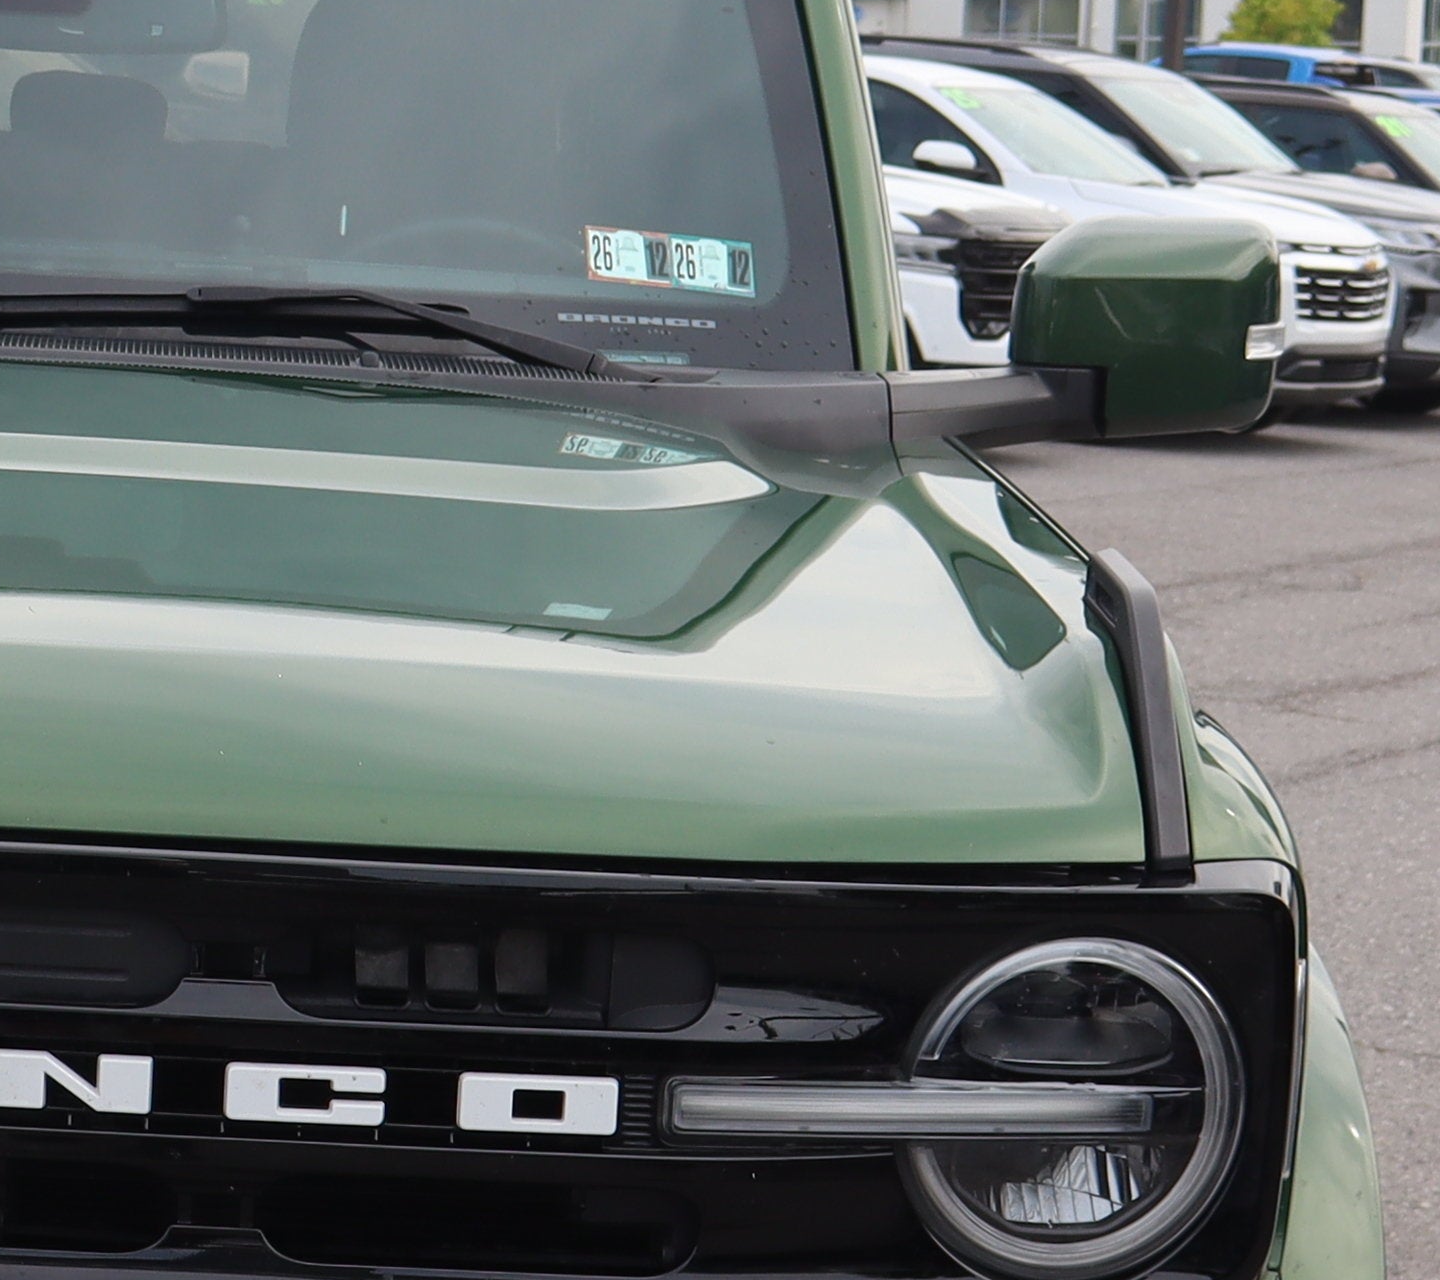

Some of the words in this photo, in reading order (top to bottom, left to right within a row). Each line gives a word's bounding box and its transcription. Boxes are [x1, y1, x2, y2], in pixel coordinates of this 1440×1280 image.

[591, 234, 614, 272] 26
[646, 240, 670, 277] 12
[674, 242, 697, 280] 26
[728, 248, 750, 286] 12
